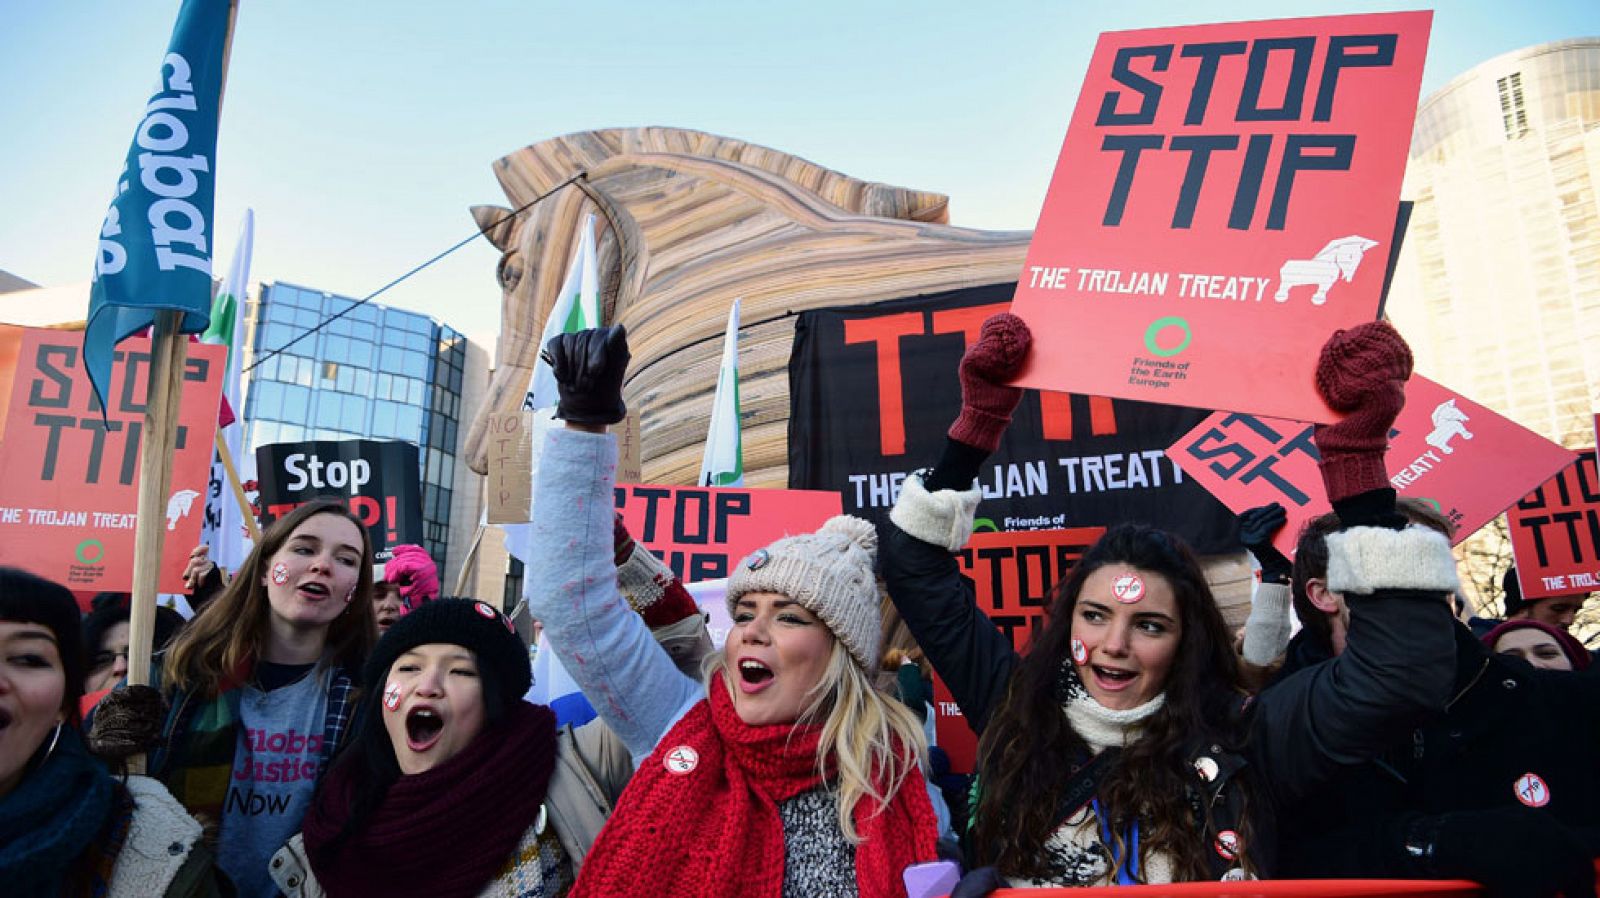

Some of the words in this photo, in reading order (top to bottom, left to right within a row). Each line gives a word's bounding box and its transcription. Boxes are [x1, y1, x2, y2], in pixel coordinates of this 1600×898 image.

[1095, 33, 1398, 127] STOP
[1100, 133, 1357, 231] TTIP
[1028, 266, 1068, 289] THE
[1076, 268, 1169, 296] TROJAN
[1177, 273, 1271, 302] TREATY
[1133, 357, 1175, 369] Friends
[1176, 362, 1190, 370] of
[1128, 375, 1170, 388] Europe
[1131, 368, 1151, 376] the
[1153, 369, 1187, 380] Earth
[488, 415, 519, 434] NO
[284, 453, 371, 495] Stop
[28, 509, 87, 527] TROJAN
[1004, 516, 1051, 527] Friends
[1052, 513, 1065, 524] of
[1541, 575, 1568, 591] THE
[939, 702, 962, 717] THE
